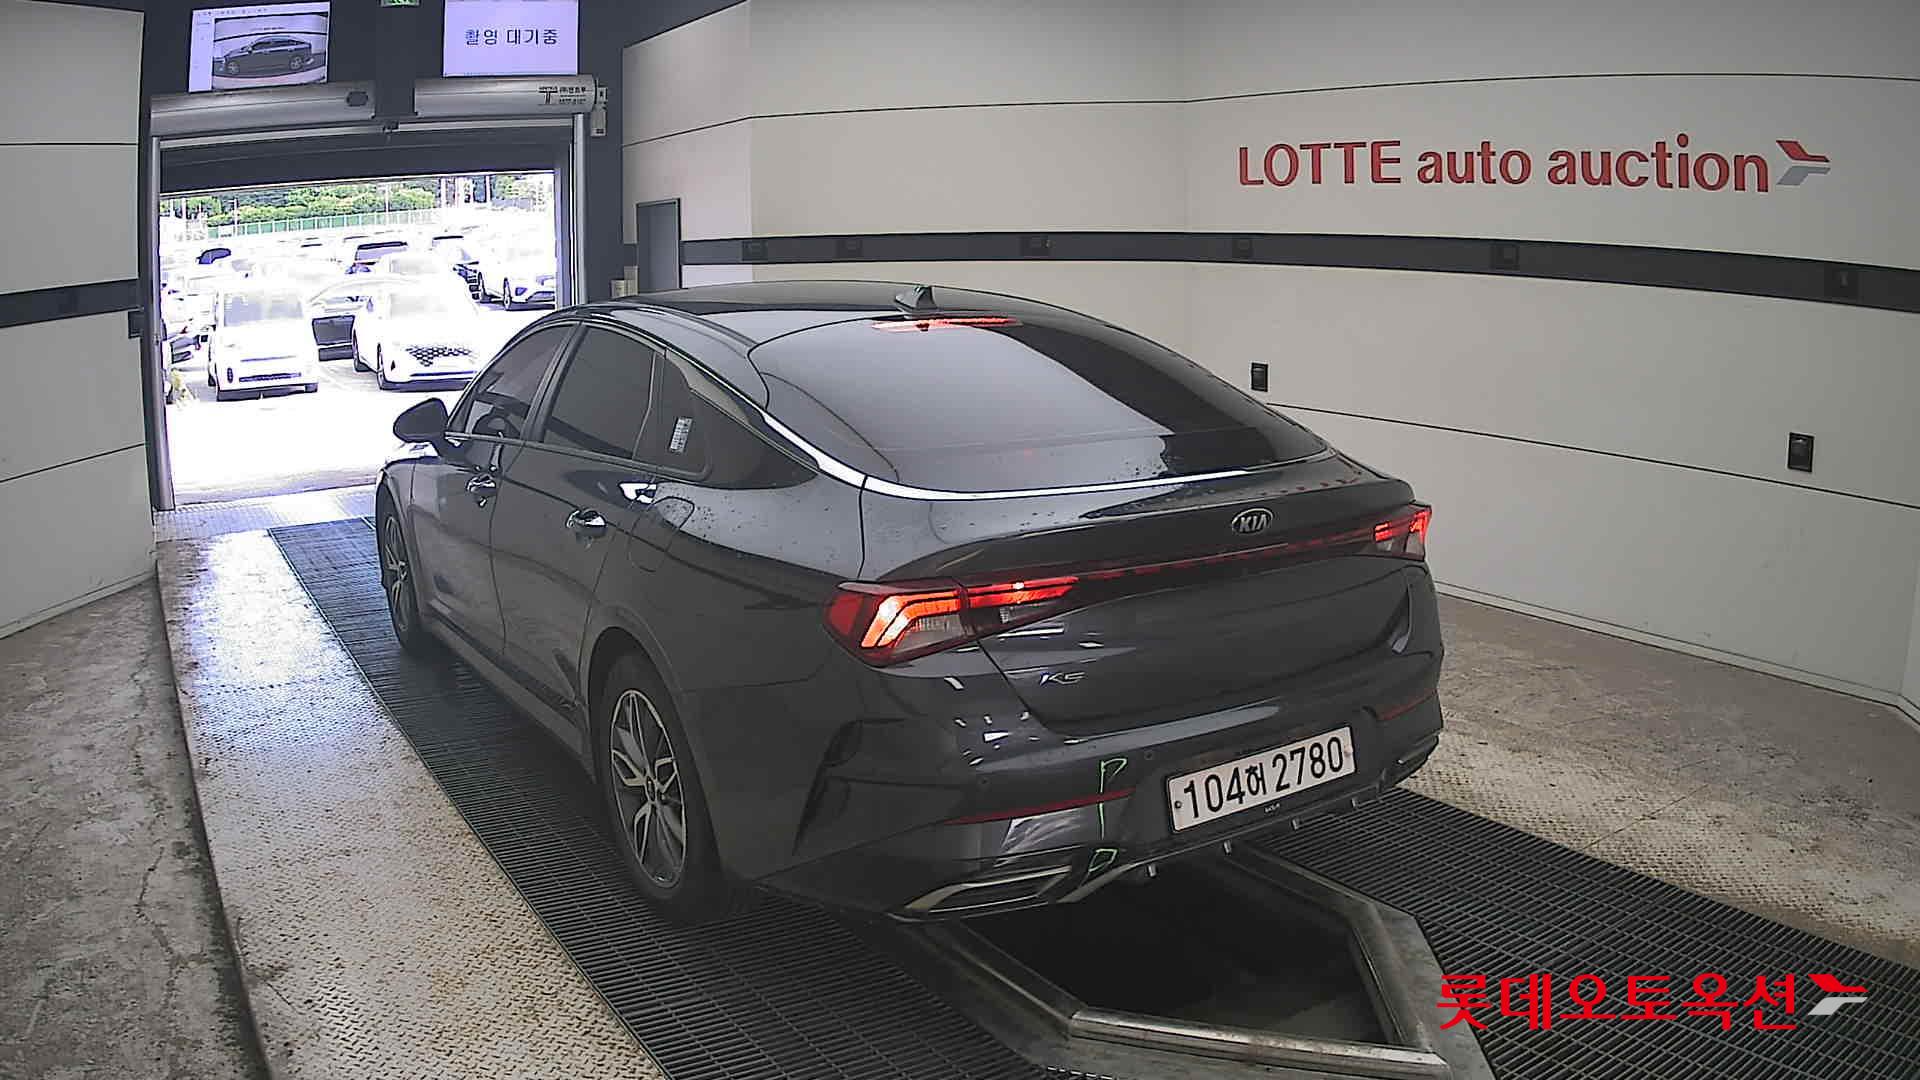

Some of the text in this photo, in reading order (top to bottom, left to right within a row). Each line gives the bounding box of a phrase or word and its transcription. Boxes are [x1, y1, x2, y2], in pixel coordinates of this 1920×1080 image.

[1238, 133, 1770, 193] LOTTE auto auction
[1238, 512, 1269, 534] KIA
[1039, 671, 1086, 686] K5
